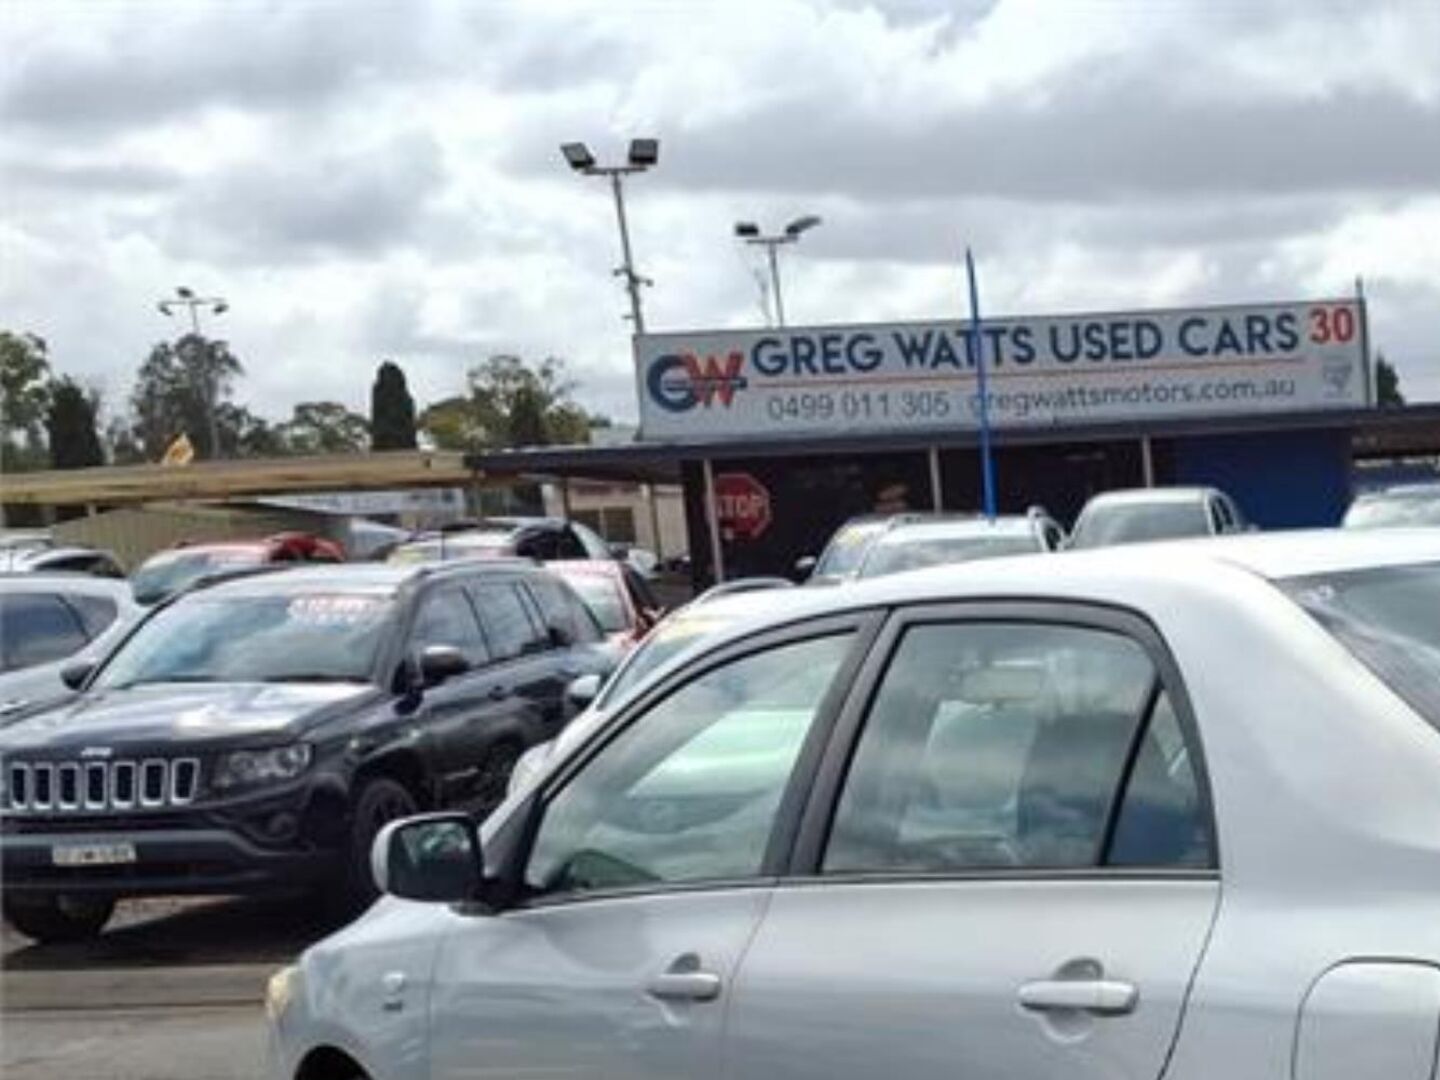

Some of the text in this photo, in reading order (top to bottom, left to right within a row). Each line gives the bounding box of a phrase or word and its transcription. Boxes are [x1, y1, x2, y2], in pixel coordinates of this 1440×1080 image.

[753, 312, 1298, 376] GREG WATTS USED CARS
[1309, 308, 1354, 344] 30
[768, 394, 834, 420] 0499
[843, 392, 890, 418] 011
[900, 390, 950, 417] 305
